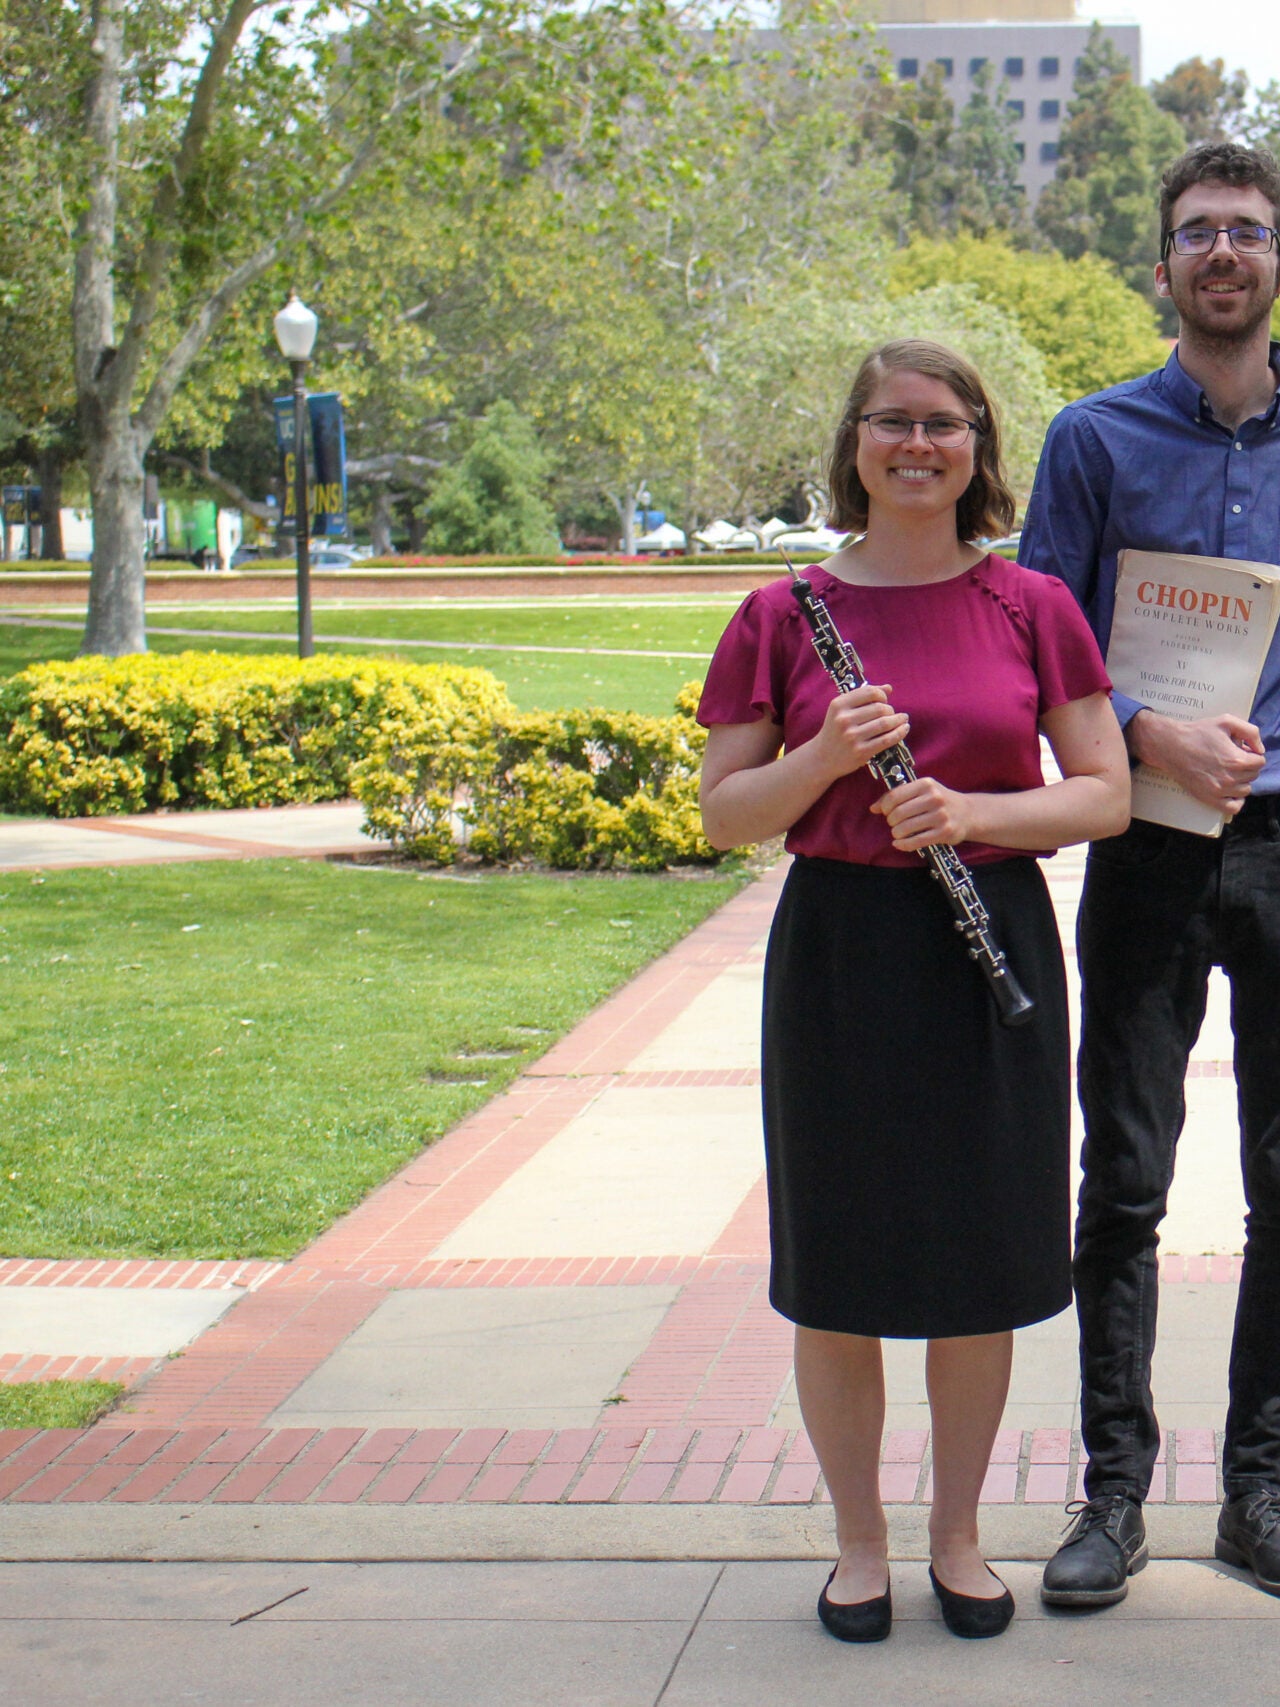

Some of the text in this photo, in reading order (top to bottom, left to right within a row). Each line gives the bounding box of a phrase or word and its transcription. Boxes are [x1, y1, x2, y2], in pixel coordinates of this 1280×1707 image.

[1137, 581, 1253, 622] CHOPIN
[1134, 606, 1249, 636] COMPLETE WORKS
[1140, 671, 1215, 693] WORKS FOR PIANO
[1140, 688, 1204, 709] AND ORCHESTRA
